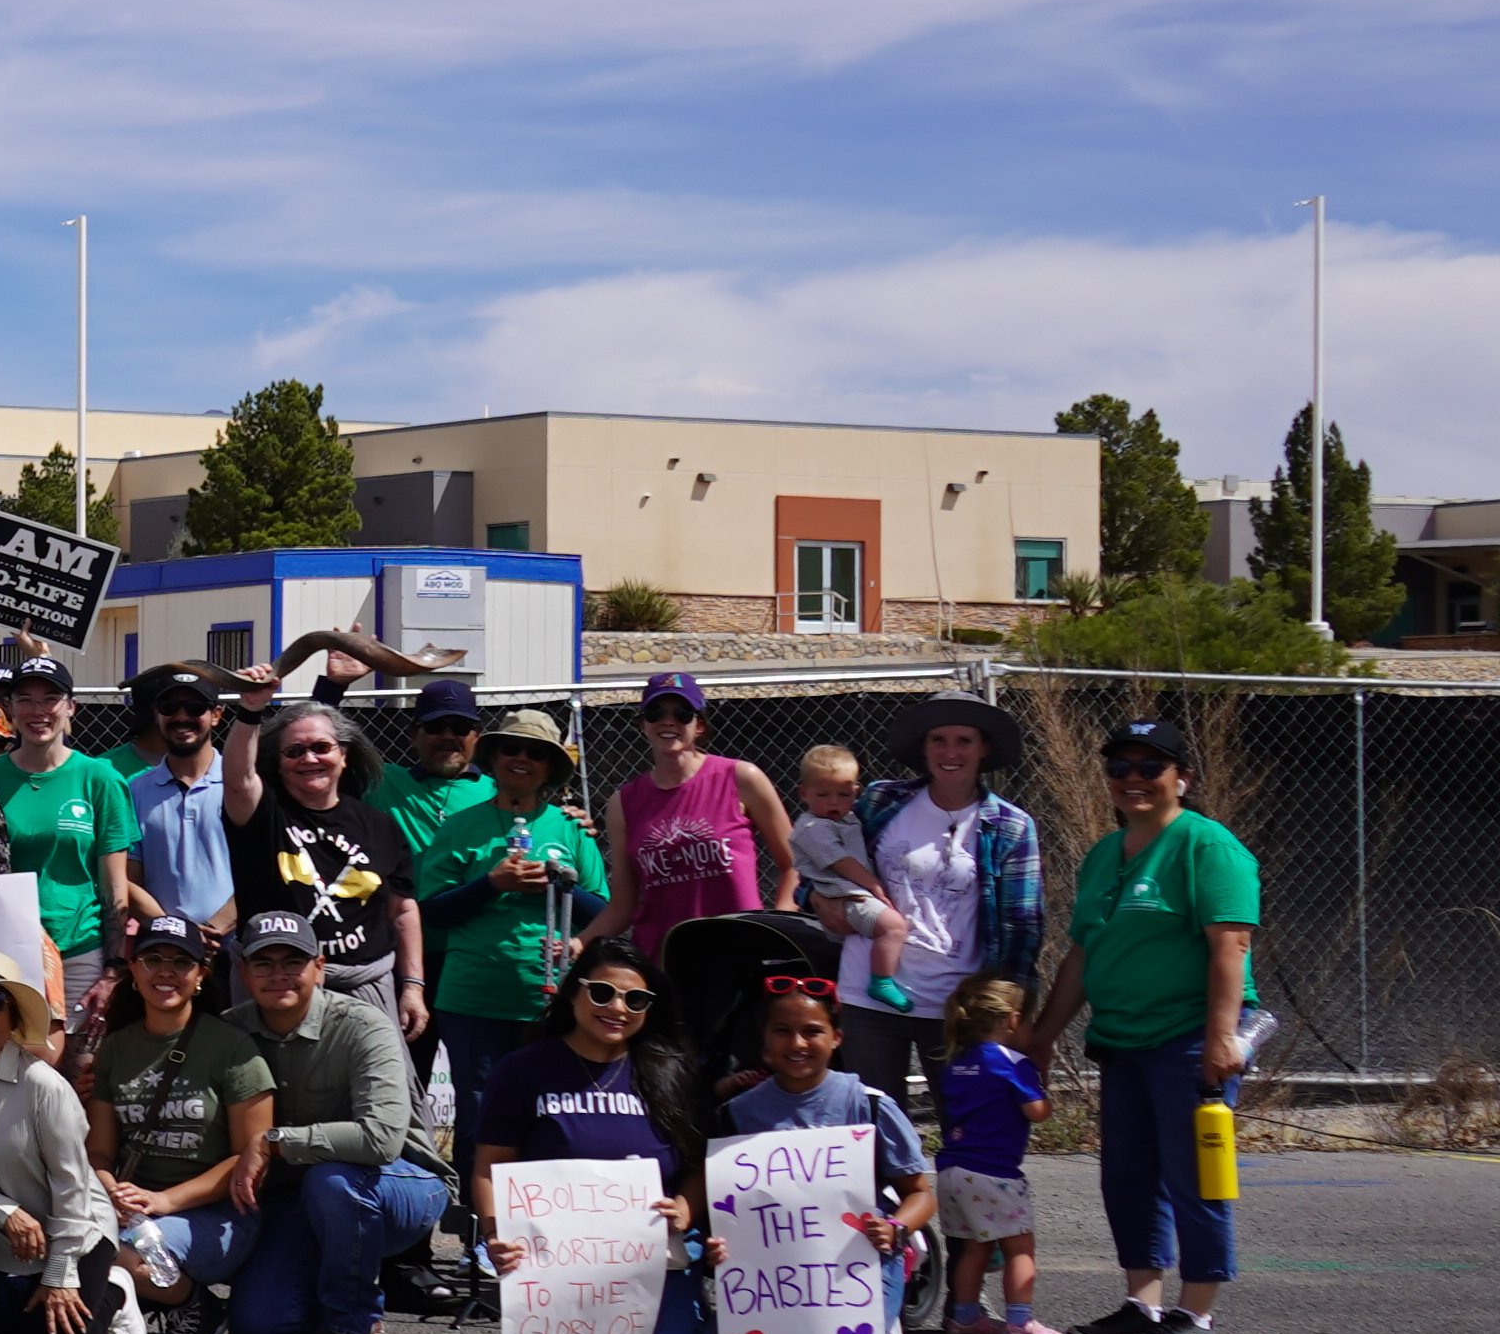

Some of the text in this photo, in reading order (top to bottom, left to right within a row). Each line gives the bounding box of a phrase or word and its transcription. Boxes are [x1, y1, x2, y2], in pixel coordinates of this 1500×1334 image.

[15, 563, 33, 575] the
[259, 917, 299, 934] DAD
[735, 1145, 847, 1192] SAVE
[507, 1177, 649, 1220] ABOLISH
[749, 1203, 826, 1249] THE
[514, 1235, 657, 1269] ABORTION
[518, 1281, 630, 1312] TO THE
[720, 1262, 873, 1315] BABIES
